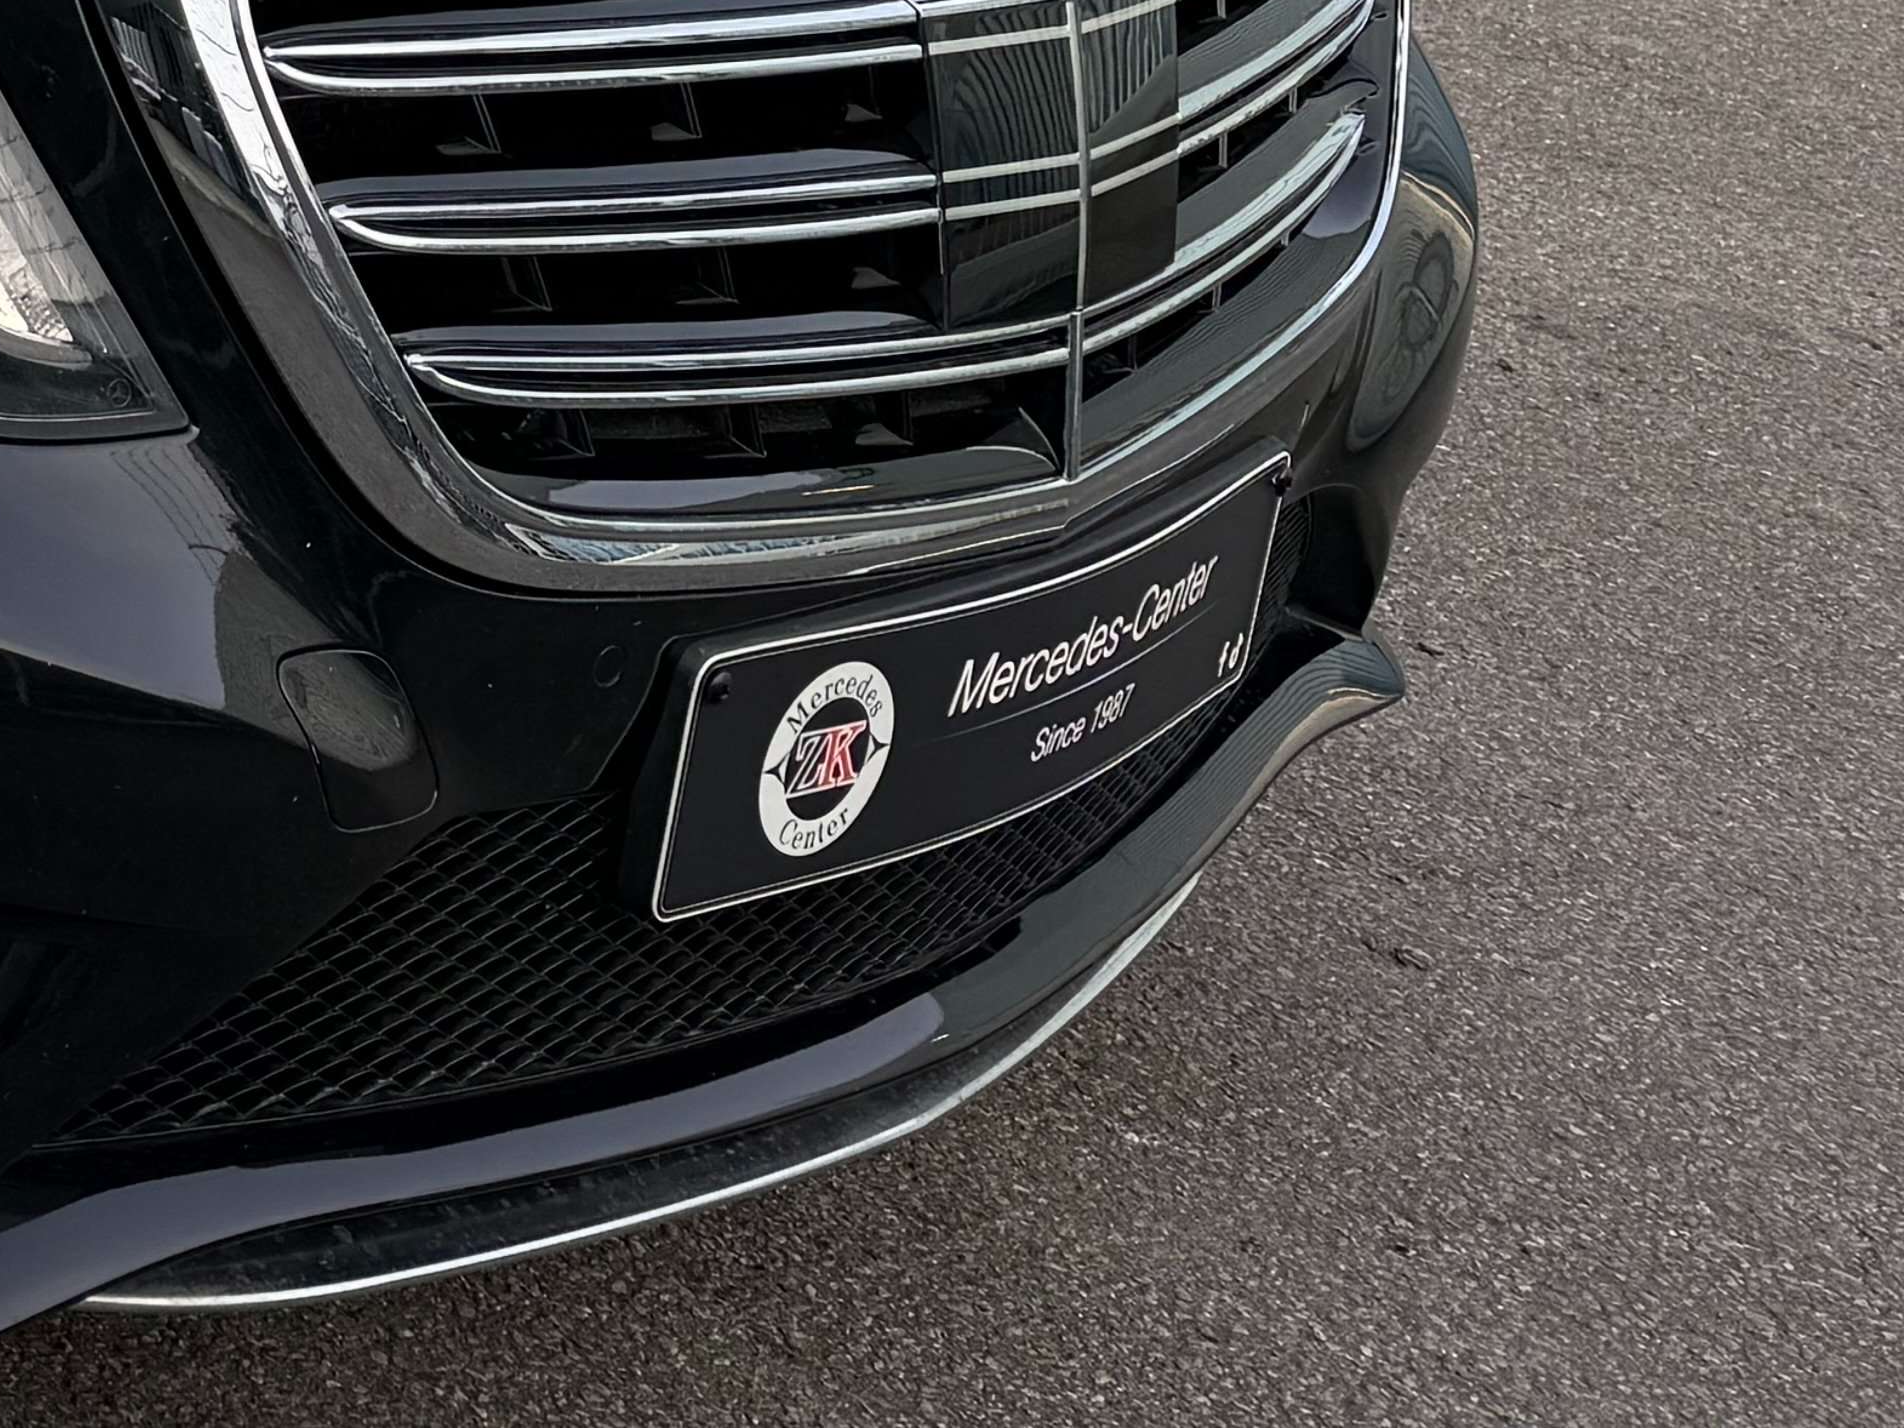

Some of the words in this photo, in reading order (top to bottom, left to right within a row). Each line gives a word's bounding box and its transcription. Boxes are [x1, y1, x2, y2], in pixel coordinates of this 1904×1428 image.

[946, 554, 1219, 718] Mercedes-Center
[786, 673, 883, 735] Mercedes
[1030, 716, 1087, 762] Since
[1090, 682, 1136, 734] 1987
[779, 806, 848, 850] Center
